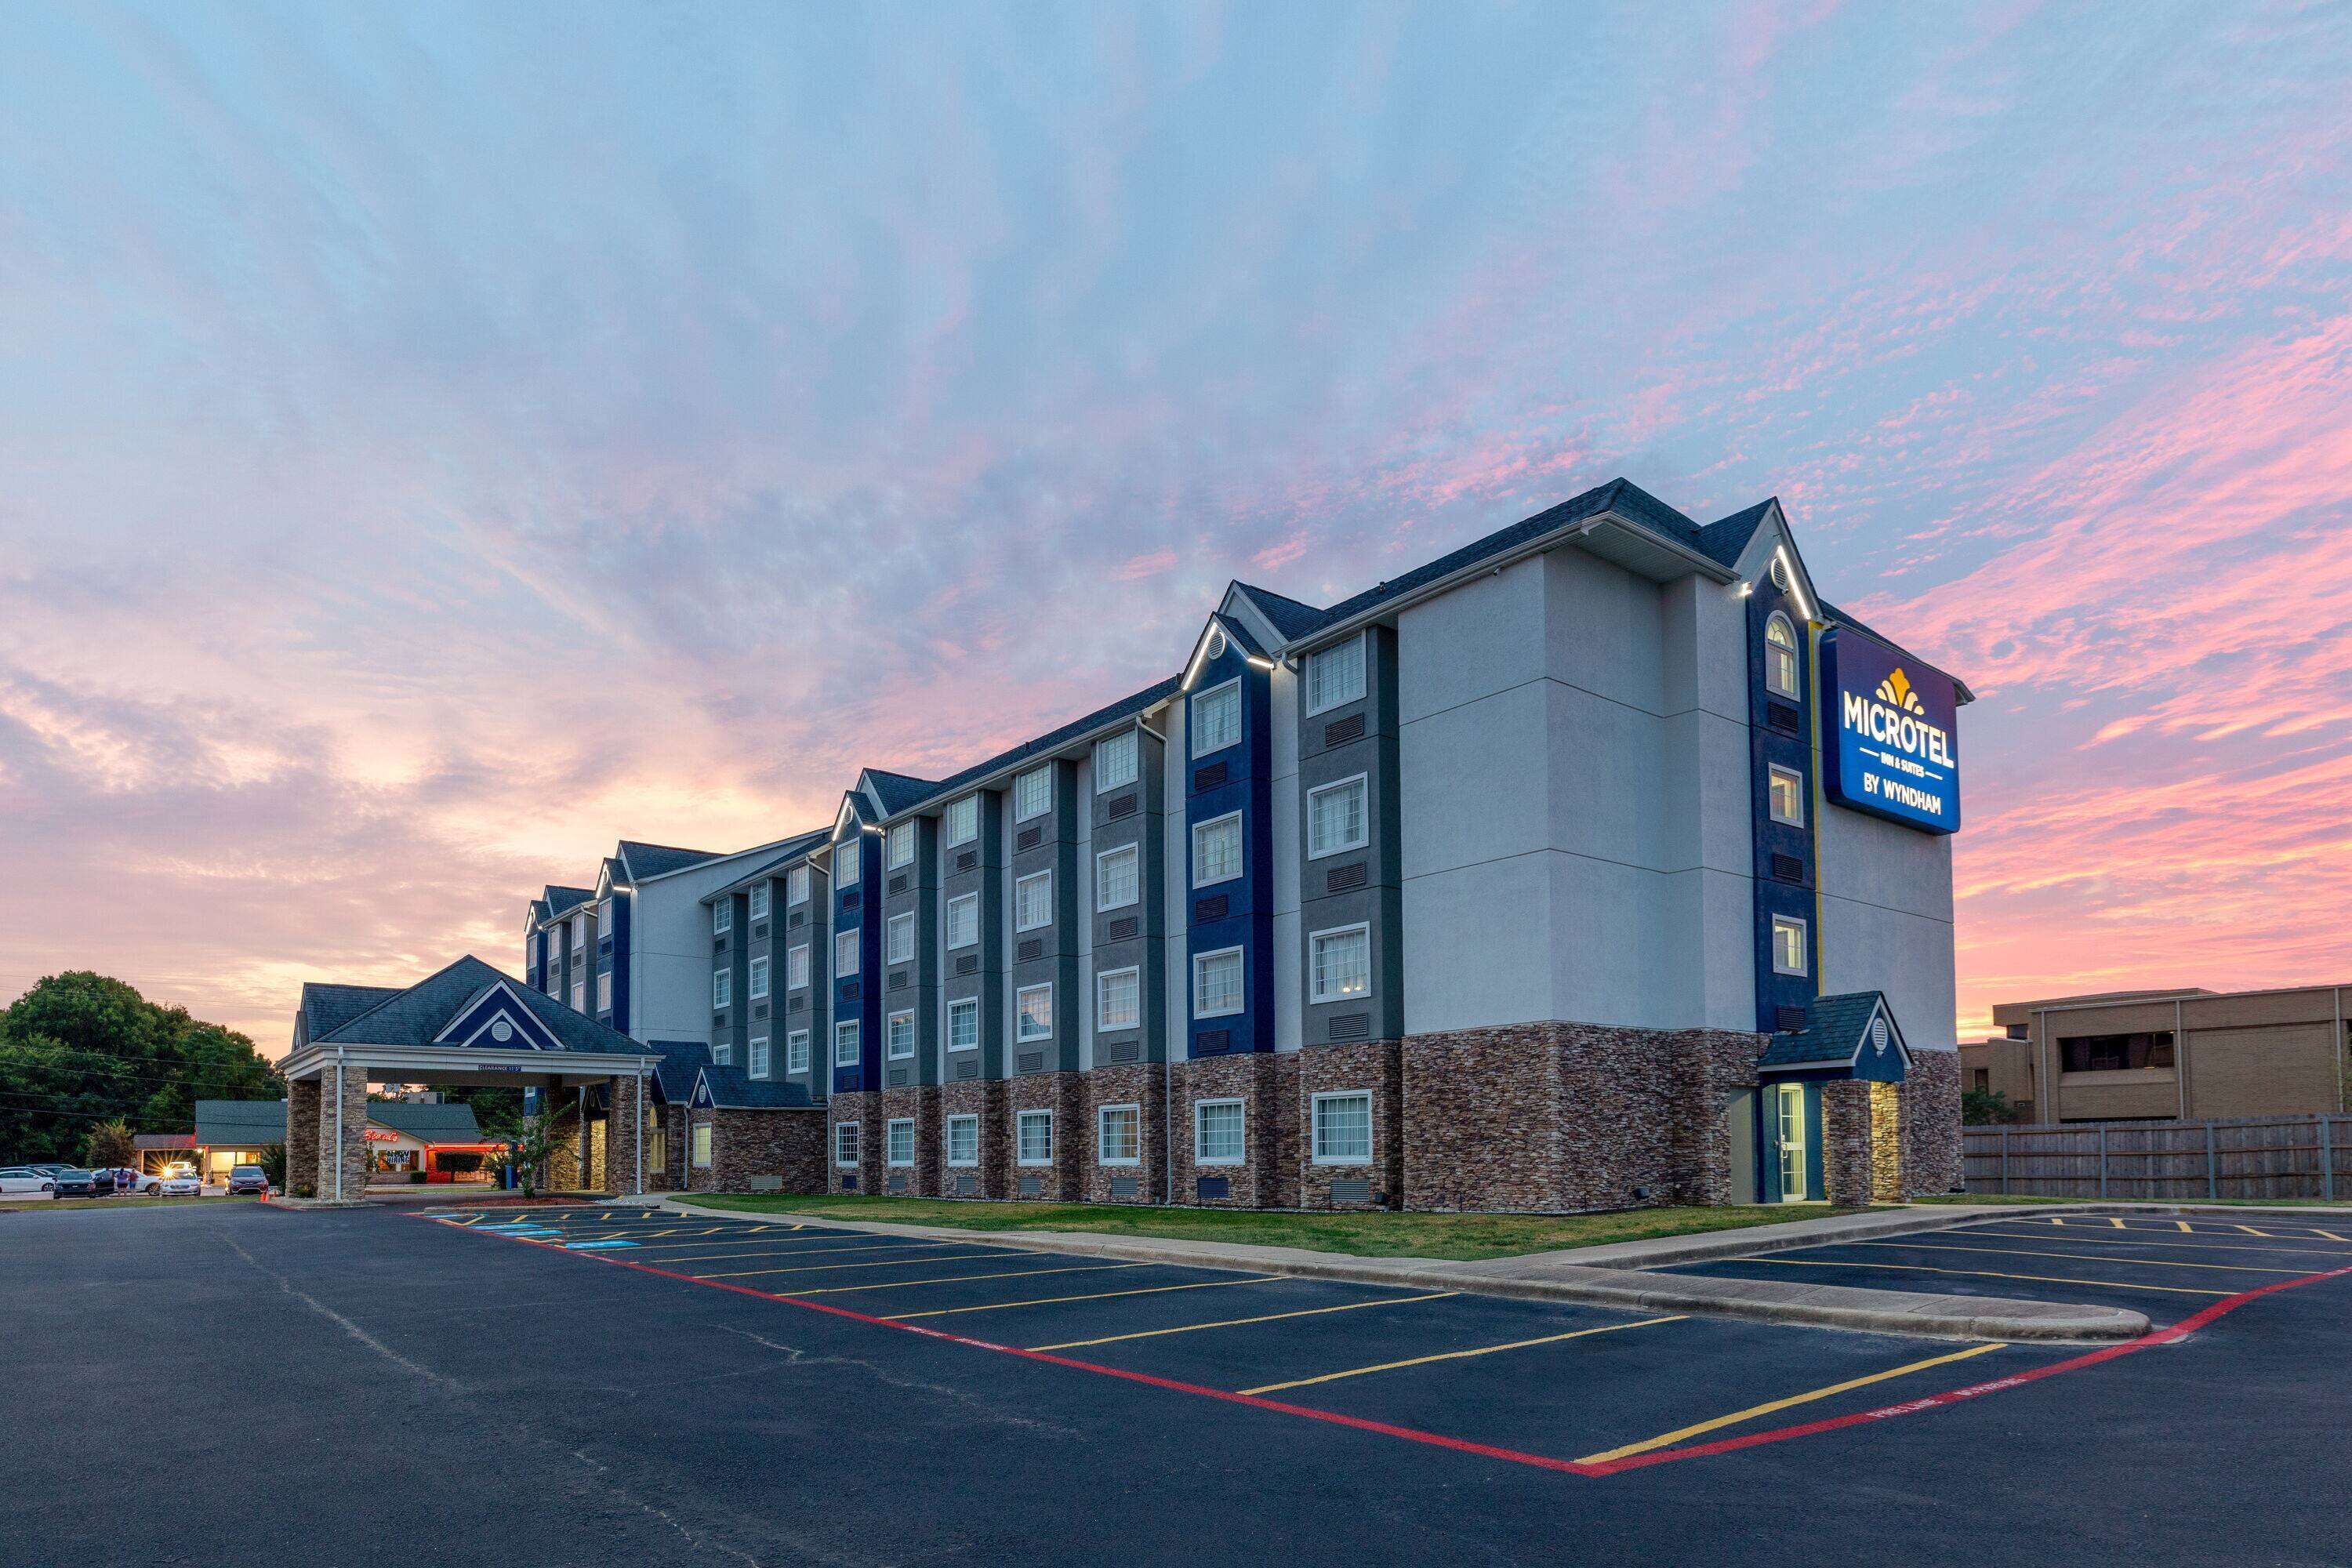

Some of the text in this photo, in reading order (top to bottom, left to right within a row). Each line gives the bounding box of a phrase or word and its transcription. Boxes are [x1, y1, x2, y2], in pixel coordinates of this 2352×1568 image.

[1844, 691, 1954, 768] MICROTEL
[1881, 752, 1924, 778] INN & SUITES
[1864, 772, 1941, 815] BY WYNDHAM
